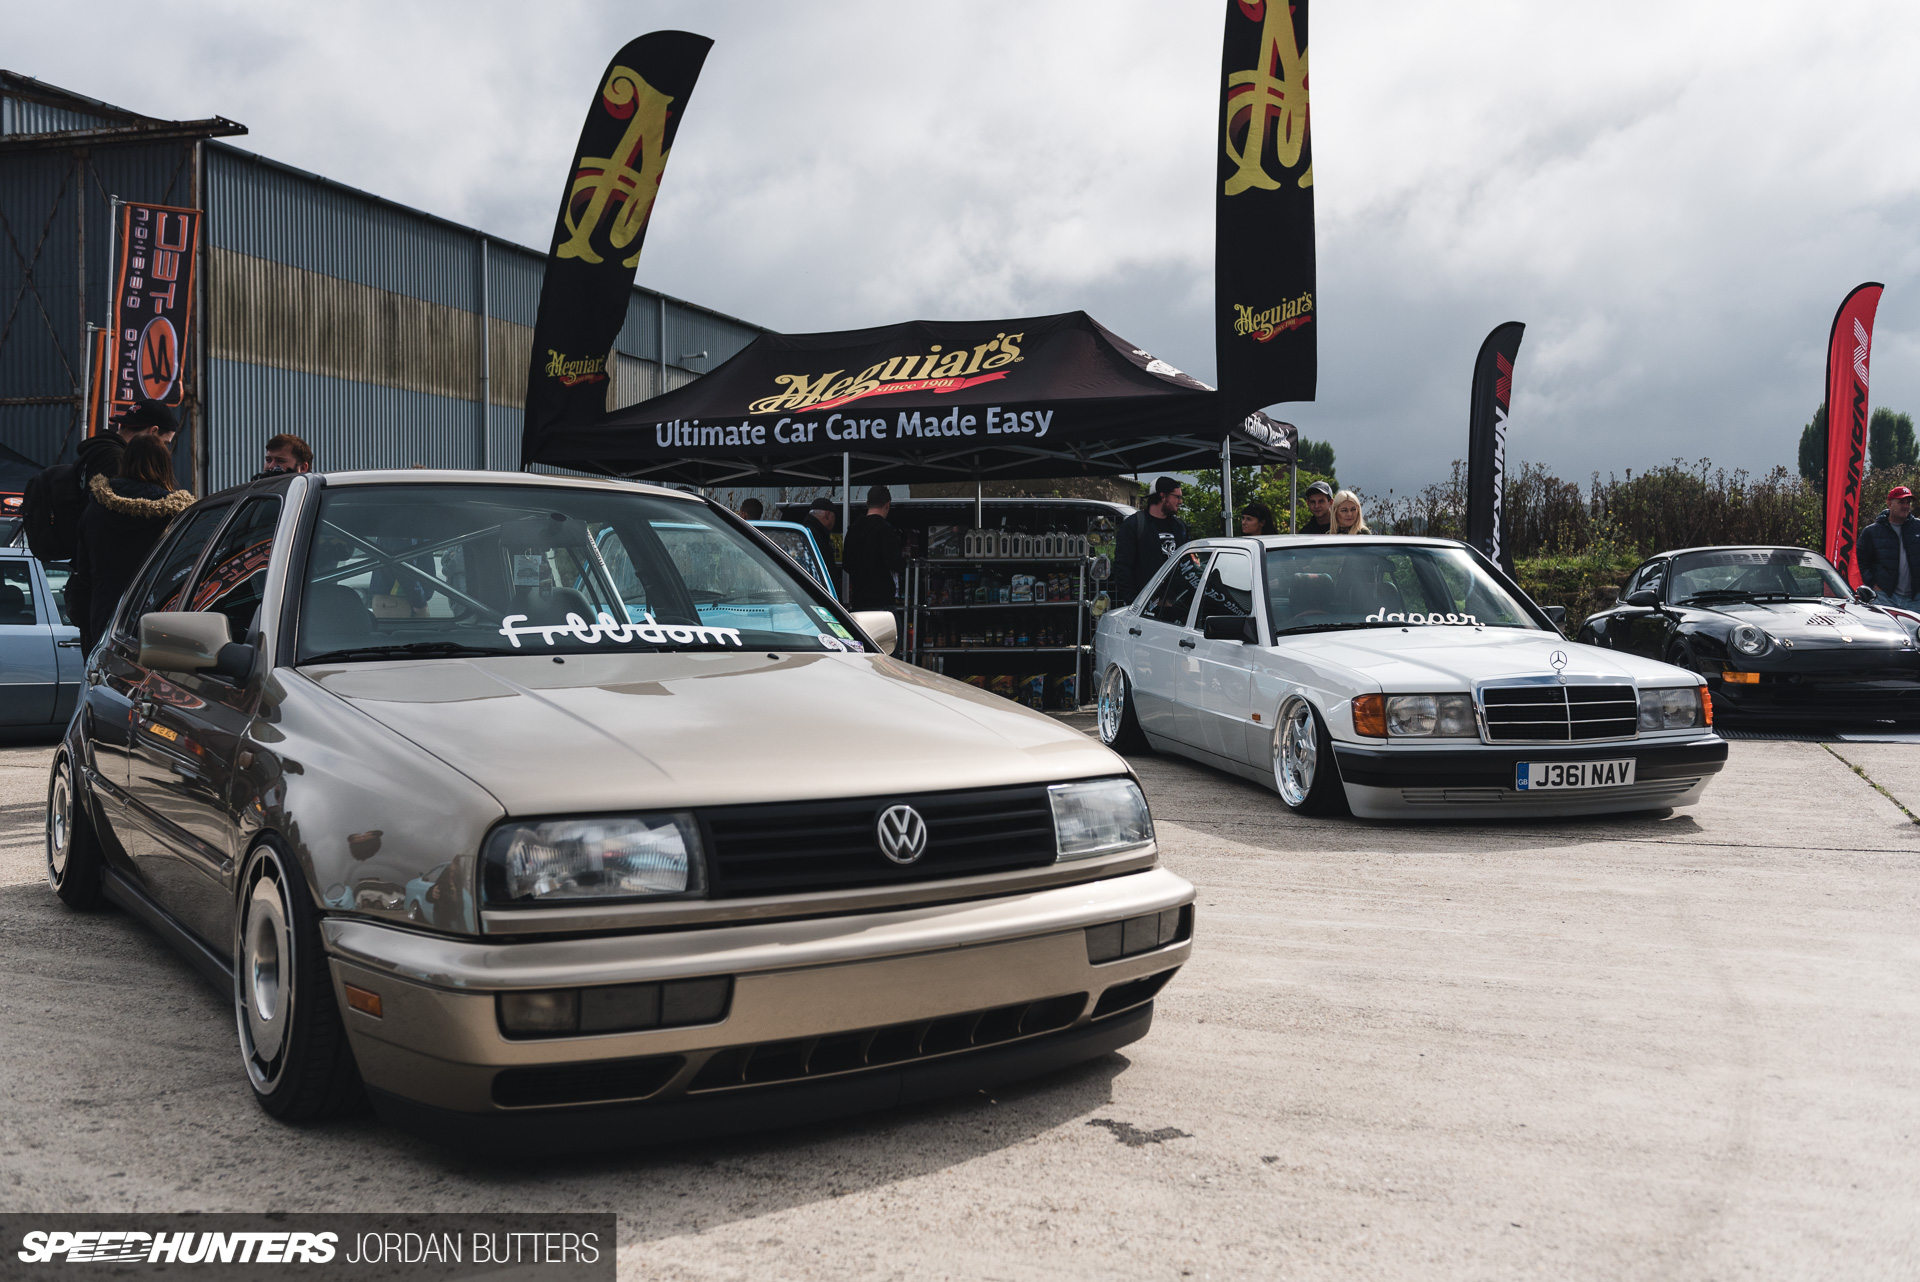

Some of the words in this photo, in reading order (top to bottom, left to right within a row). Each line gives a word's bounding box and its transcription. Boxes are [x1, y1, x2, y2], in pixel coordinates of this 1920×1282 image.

[1234, 291, 1313, 340] Meguiar's
[748, 332, 1025, 414] Meguiar's
[874, 382, 917, 393] since
[921, 380, 955, 389] 1901
[655, 418, 766, 447] Ultimate
[773, 418, 819, 444] Car
[825, 413, 887, 441] Care
[896, 407, 977, 438] Made
[986, 407, 1053, 437] Easy
[499, 612, 743, 648] freedom
[1535, 764, 1586, 787] J361
[1591, 762, 1630, 785] NAV
